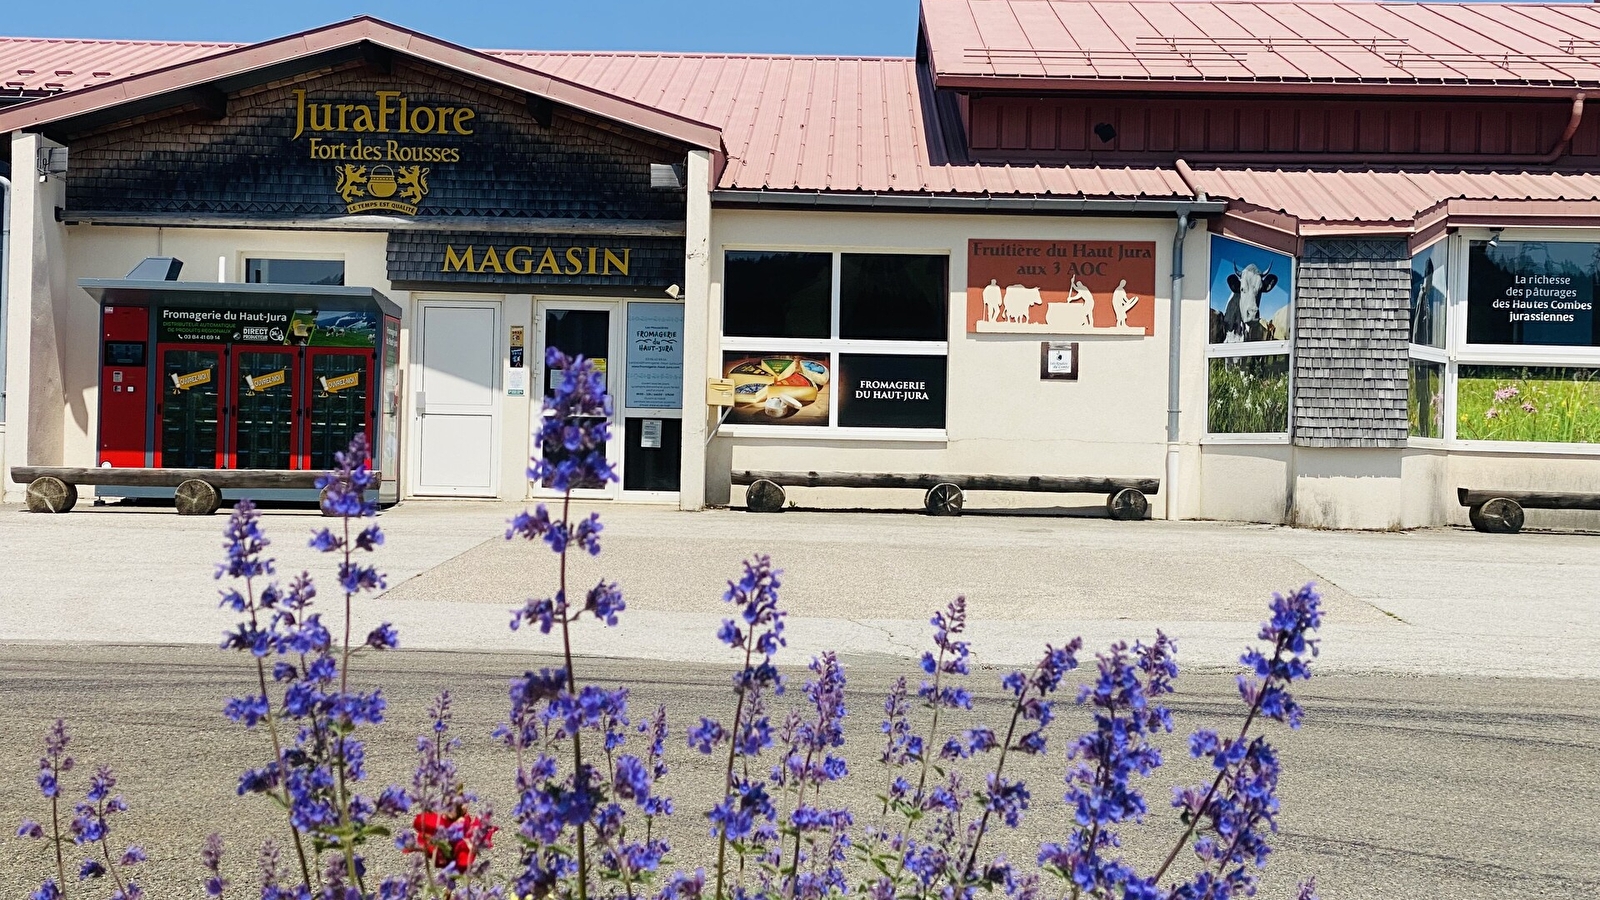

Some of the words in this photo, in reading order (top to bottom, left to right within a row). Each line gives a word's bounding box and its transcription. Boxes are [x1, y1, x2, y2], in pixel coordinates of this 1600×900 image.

[292, 88, 475, 141] JuraFlore
[309, 138, 347, 160] Fort
[350, 138, 382, 160] des
[386, 140, 460, 162] Rousses
[391, 202, 414, 214] QUALITÉ
[973, 242, 1041, 257] Fruitière
[1046, 243, 1067, 258] du
[1072, 244, 1114, 258] Haut
[1118, 244, 1152, 262] Jura
[441, 244, 632, 276] MAGASIN
[1016, 264, 1046, 274] aux
[1052, 262, 1060, 275] 3
[1067, 262, 1108, 276] AOC
[1515, 275, 1526, 284] La
[1528, 274, 1571, 284] richesse
[1506, 286, 1524, 296] des
[1526, 286, 1577, 299] pâturages
[1492, 298, 1510, 308] des
[1512, 300, 1548, 309] Hautes
[1550, 300, 1592, 310] Combes
[163, 310, 222, 322] Fromagerie
[224, 310, 236, 320] du
[240, 312, 287, 323] Haut-Jura
[1510, 311, 1574, 322] jurassiennes
[860, 380, 926, 390] FROMAGERIE
[855, 390, 871, 399] DU
[873, 390, 929, 401] HAUT-JURA
